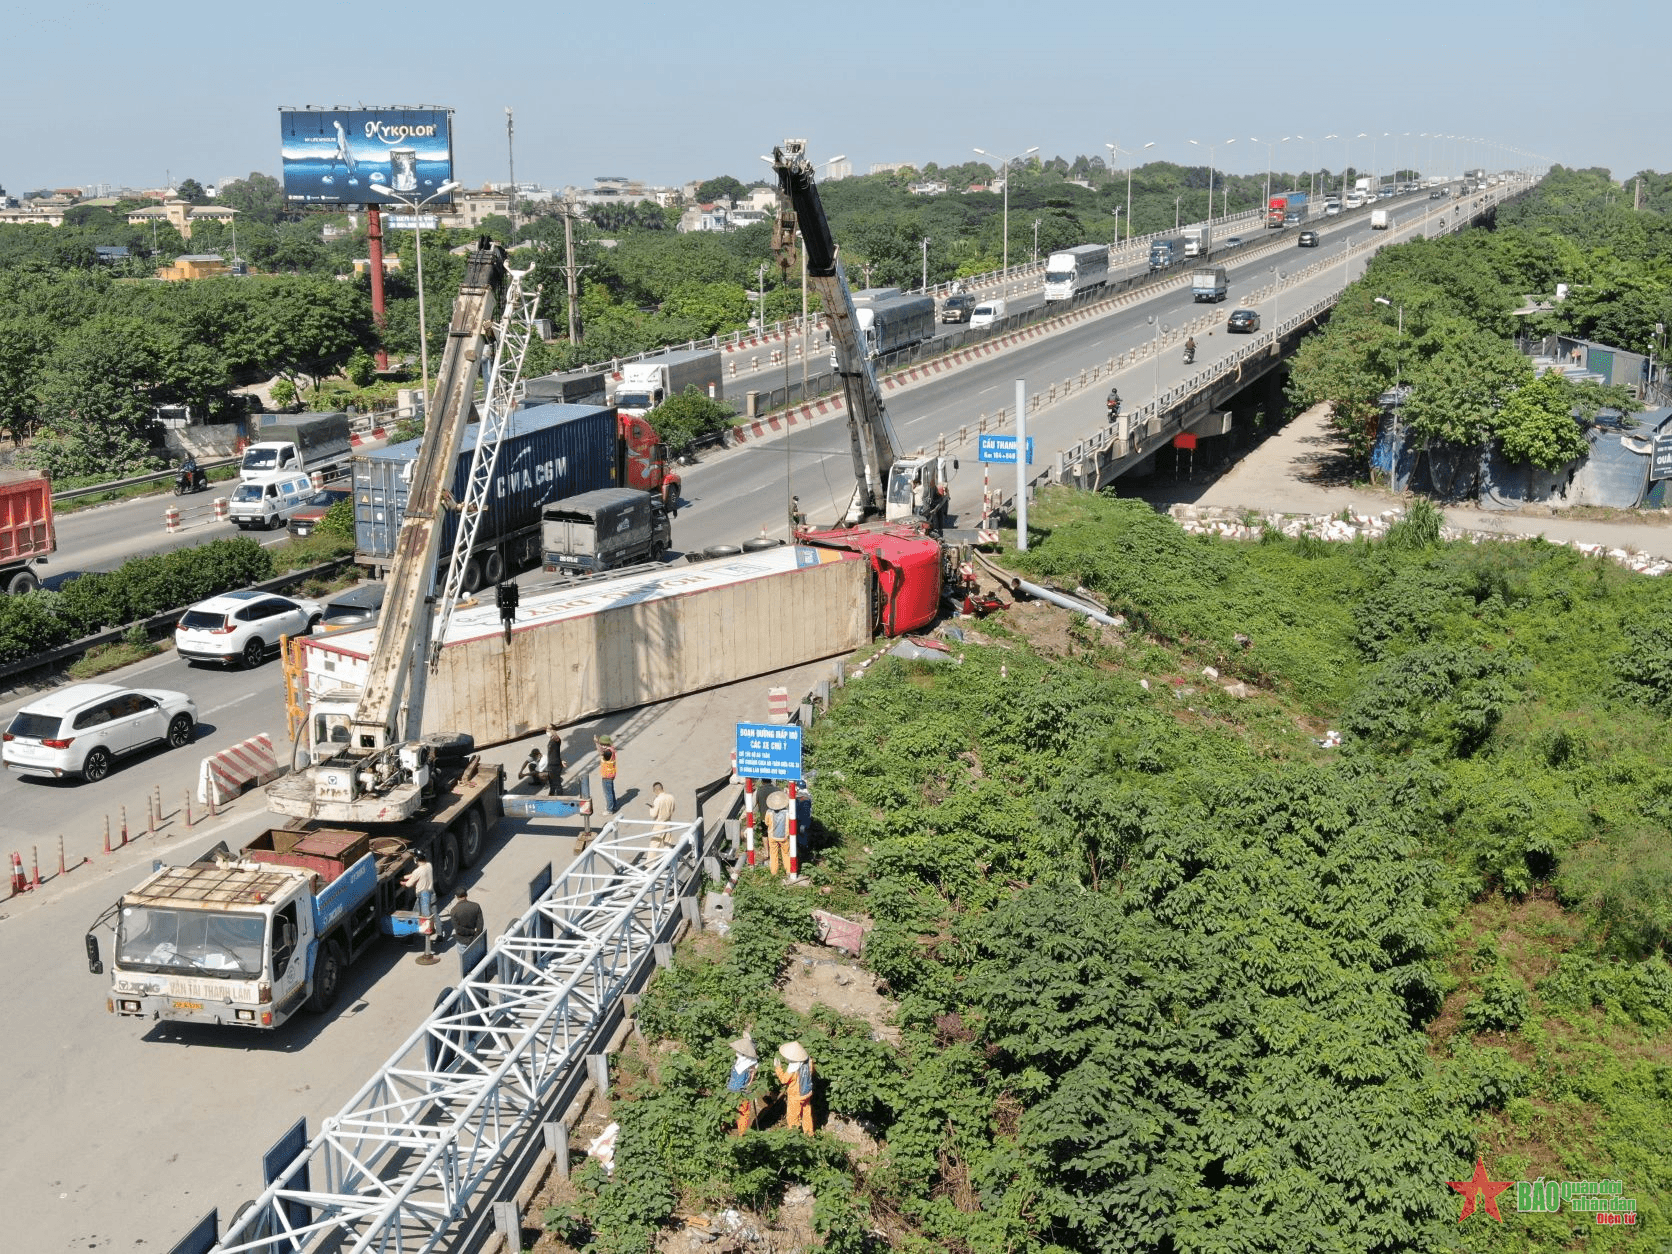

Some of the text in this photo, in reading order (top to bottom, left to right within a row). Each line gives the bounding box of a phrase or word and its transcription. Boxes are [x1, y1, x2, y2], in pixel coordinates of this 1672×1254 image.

[365, 121, 434, 144] MYKOLOR
[497, 456, 567, 498] CMA CGM
